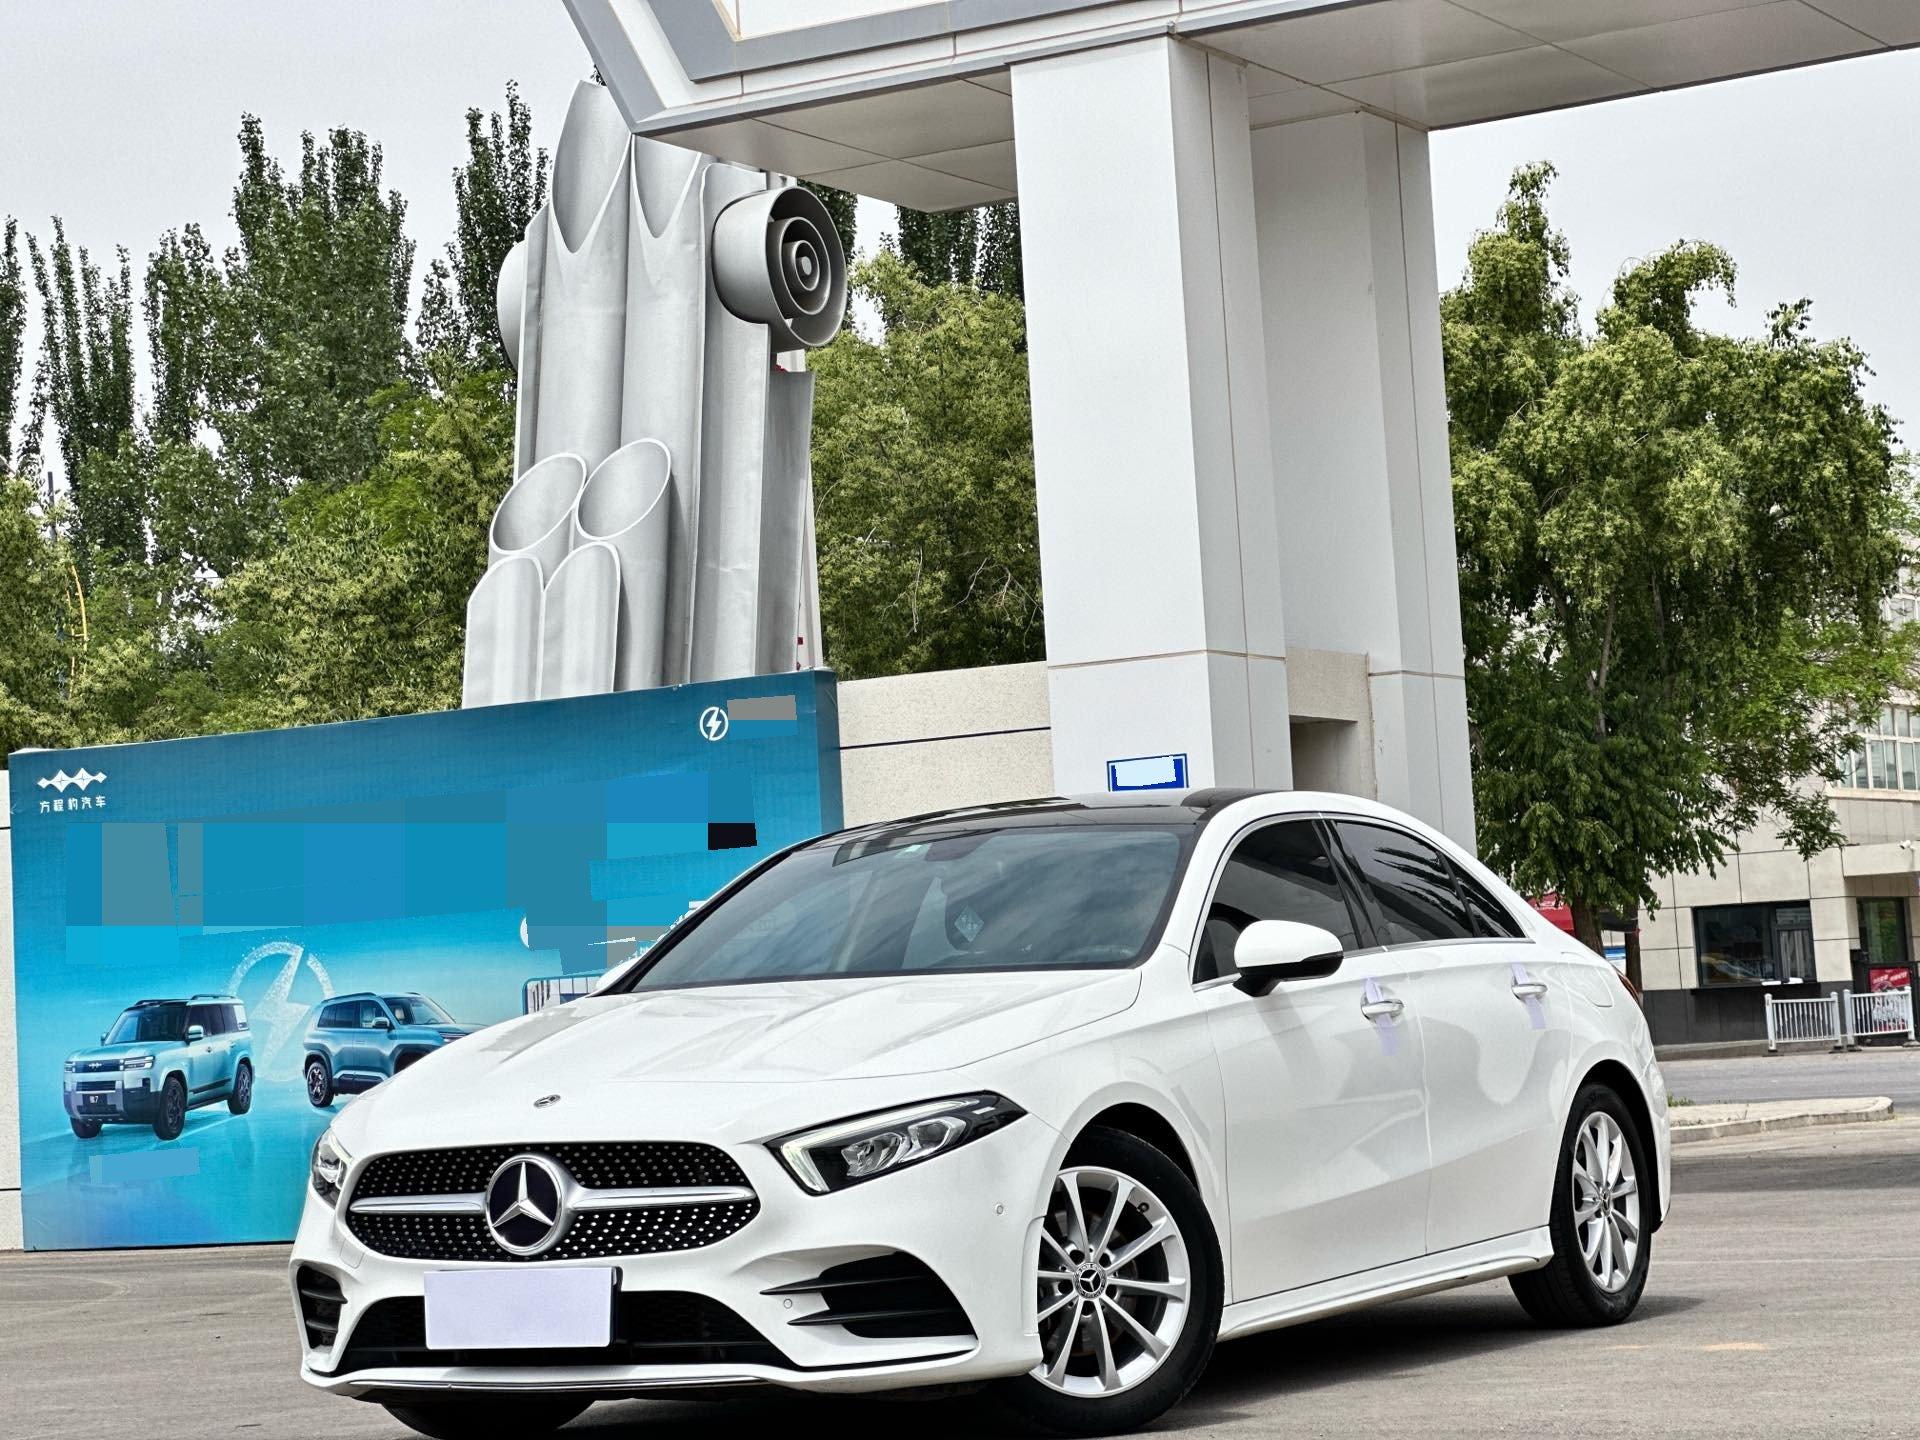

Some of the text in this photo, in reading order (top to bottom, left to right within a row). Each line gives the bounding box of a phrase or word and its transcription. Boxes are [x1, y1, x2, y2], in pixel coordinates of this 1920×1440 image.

[39, 795, 107, 814] 方程豹汽车
